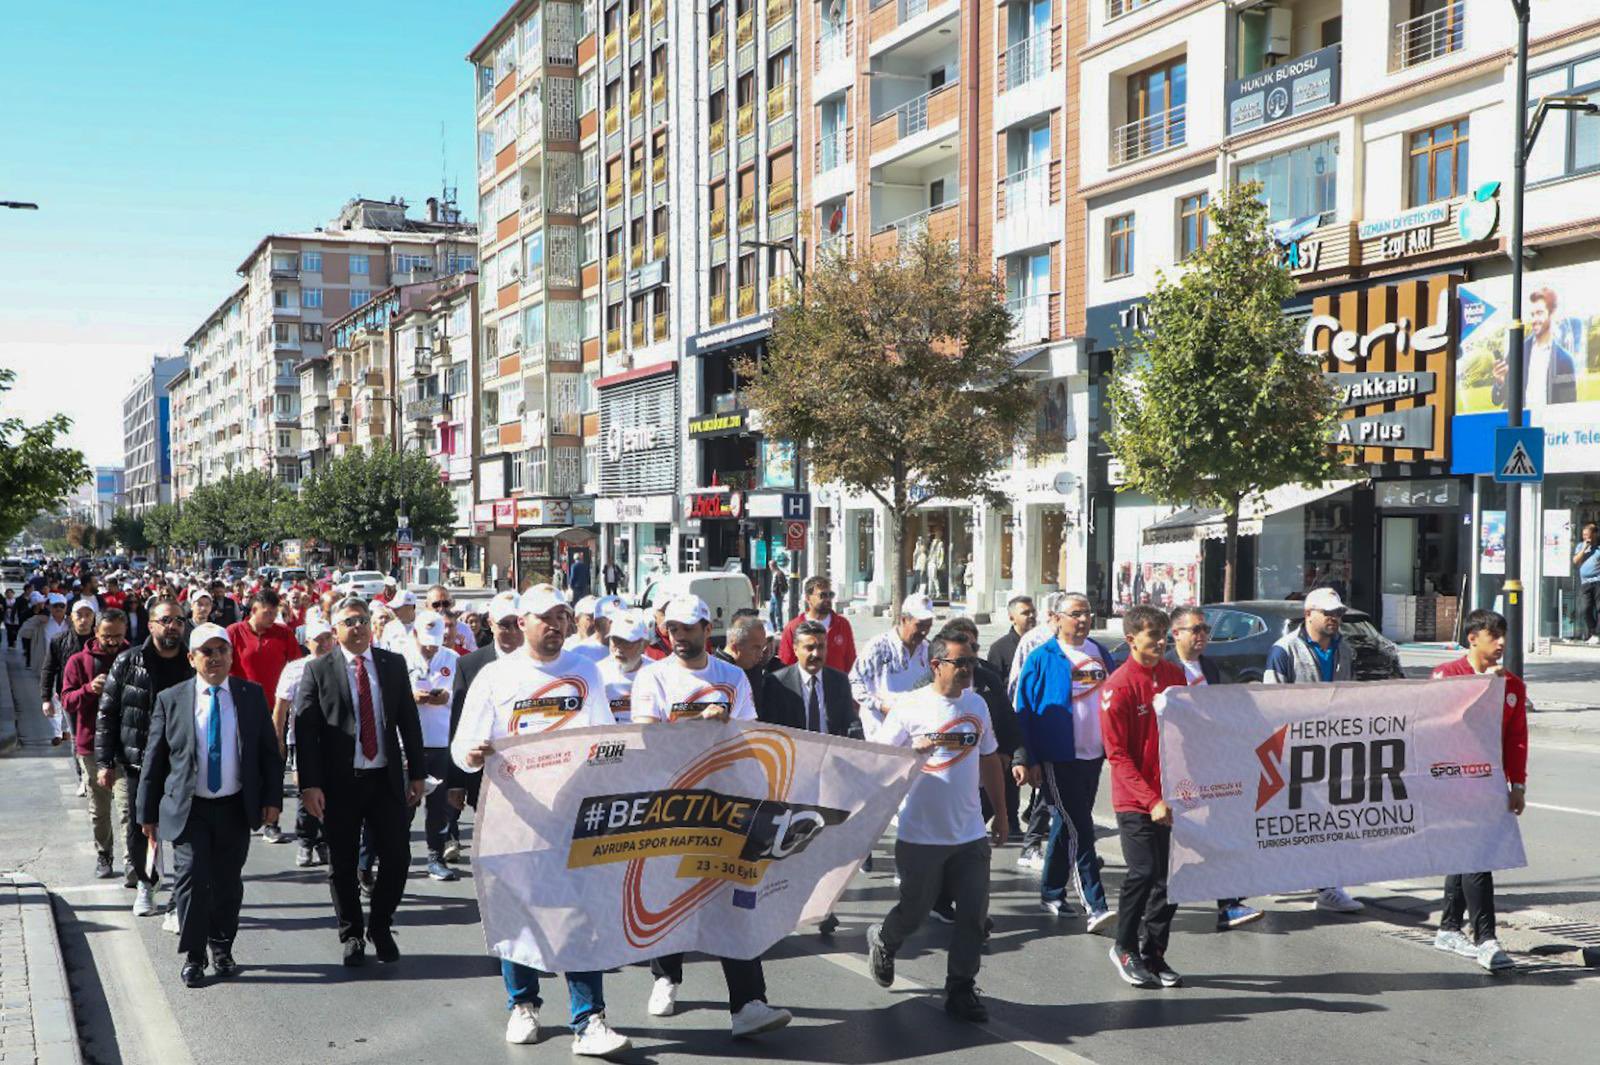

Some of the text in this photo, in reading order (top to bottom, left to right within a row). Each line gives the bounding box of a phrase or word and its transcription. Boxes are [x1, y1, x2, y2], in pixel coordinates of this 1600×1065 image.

[1240, 73, 1273, 94] HUKUK
[1276, 57, 1318, 82] BÜROSU
[1360, 221, 1391, 237] UZMAN
[1380, 228, 1432, 259] Ezgi ARI
[1342, 375, 1416, 403] yakkabı
[1359, 422, 1402, 441] Plus
[789, 498, 804, 516] H
[564, 697, 578, 710] 10
[1291, 718, 1363, 739] HERKES
[1255, 724, 1408, 812] SPOR
[584, 794, 750, 831] #BEACTIVE
[1255, 804, 1414, 837] FEDERASYONU
[593, 835, 722, 856] AVRUPA SPOR HAFTASI
[1258, 826, 1415, 849] TURKISH SPORTS FOR ALL FEDERATION
[696, 860, 711, 872] 23
[722, 861, 735, 875] 30
